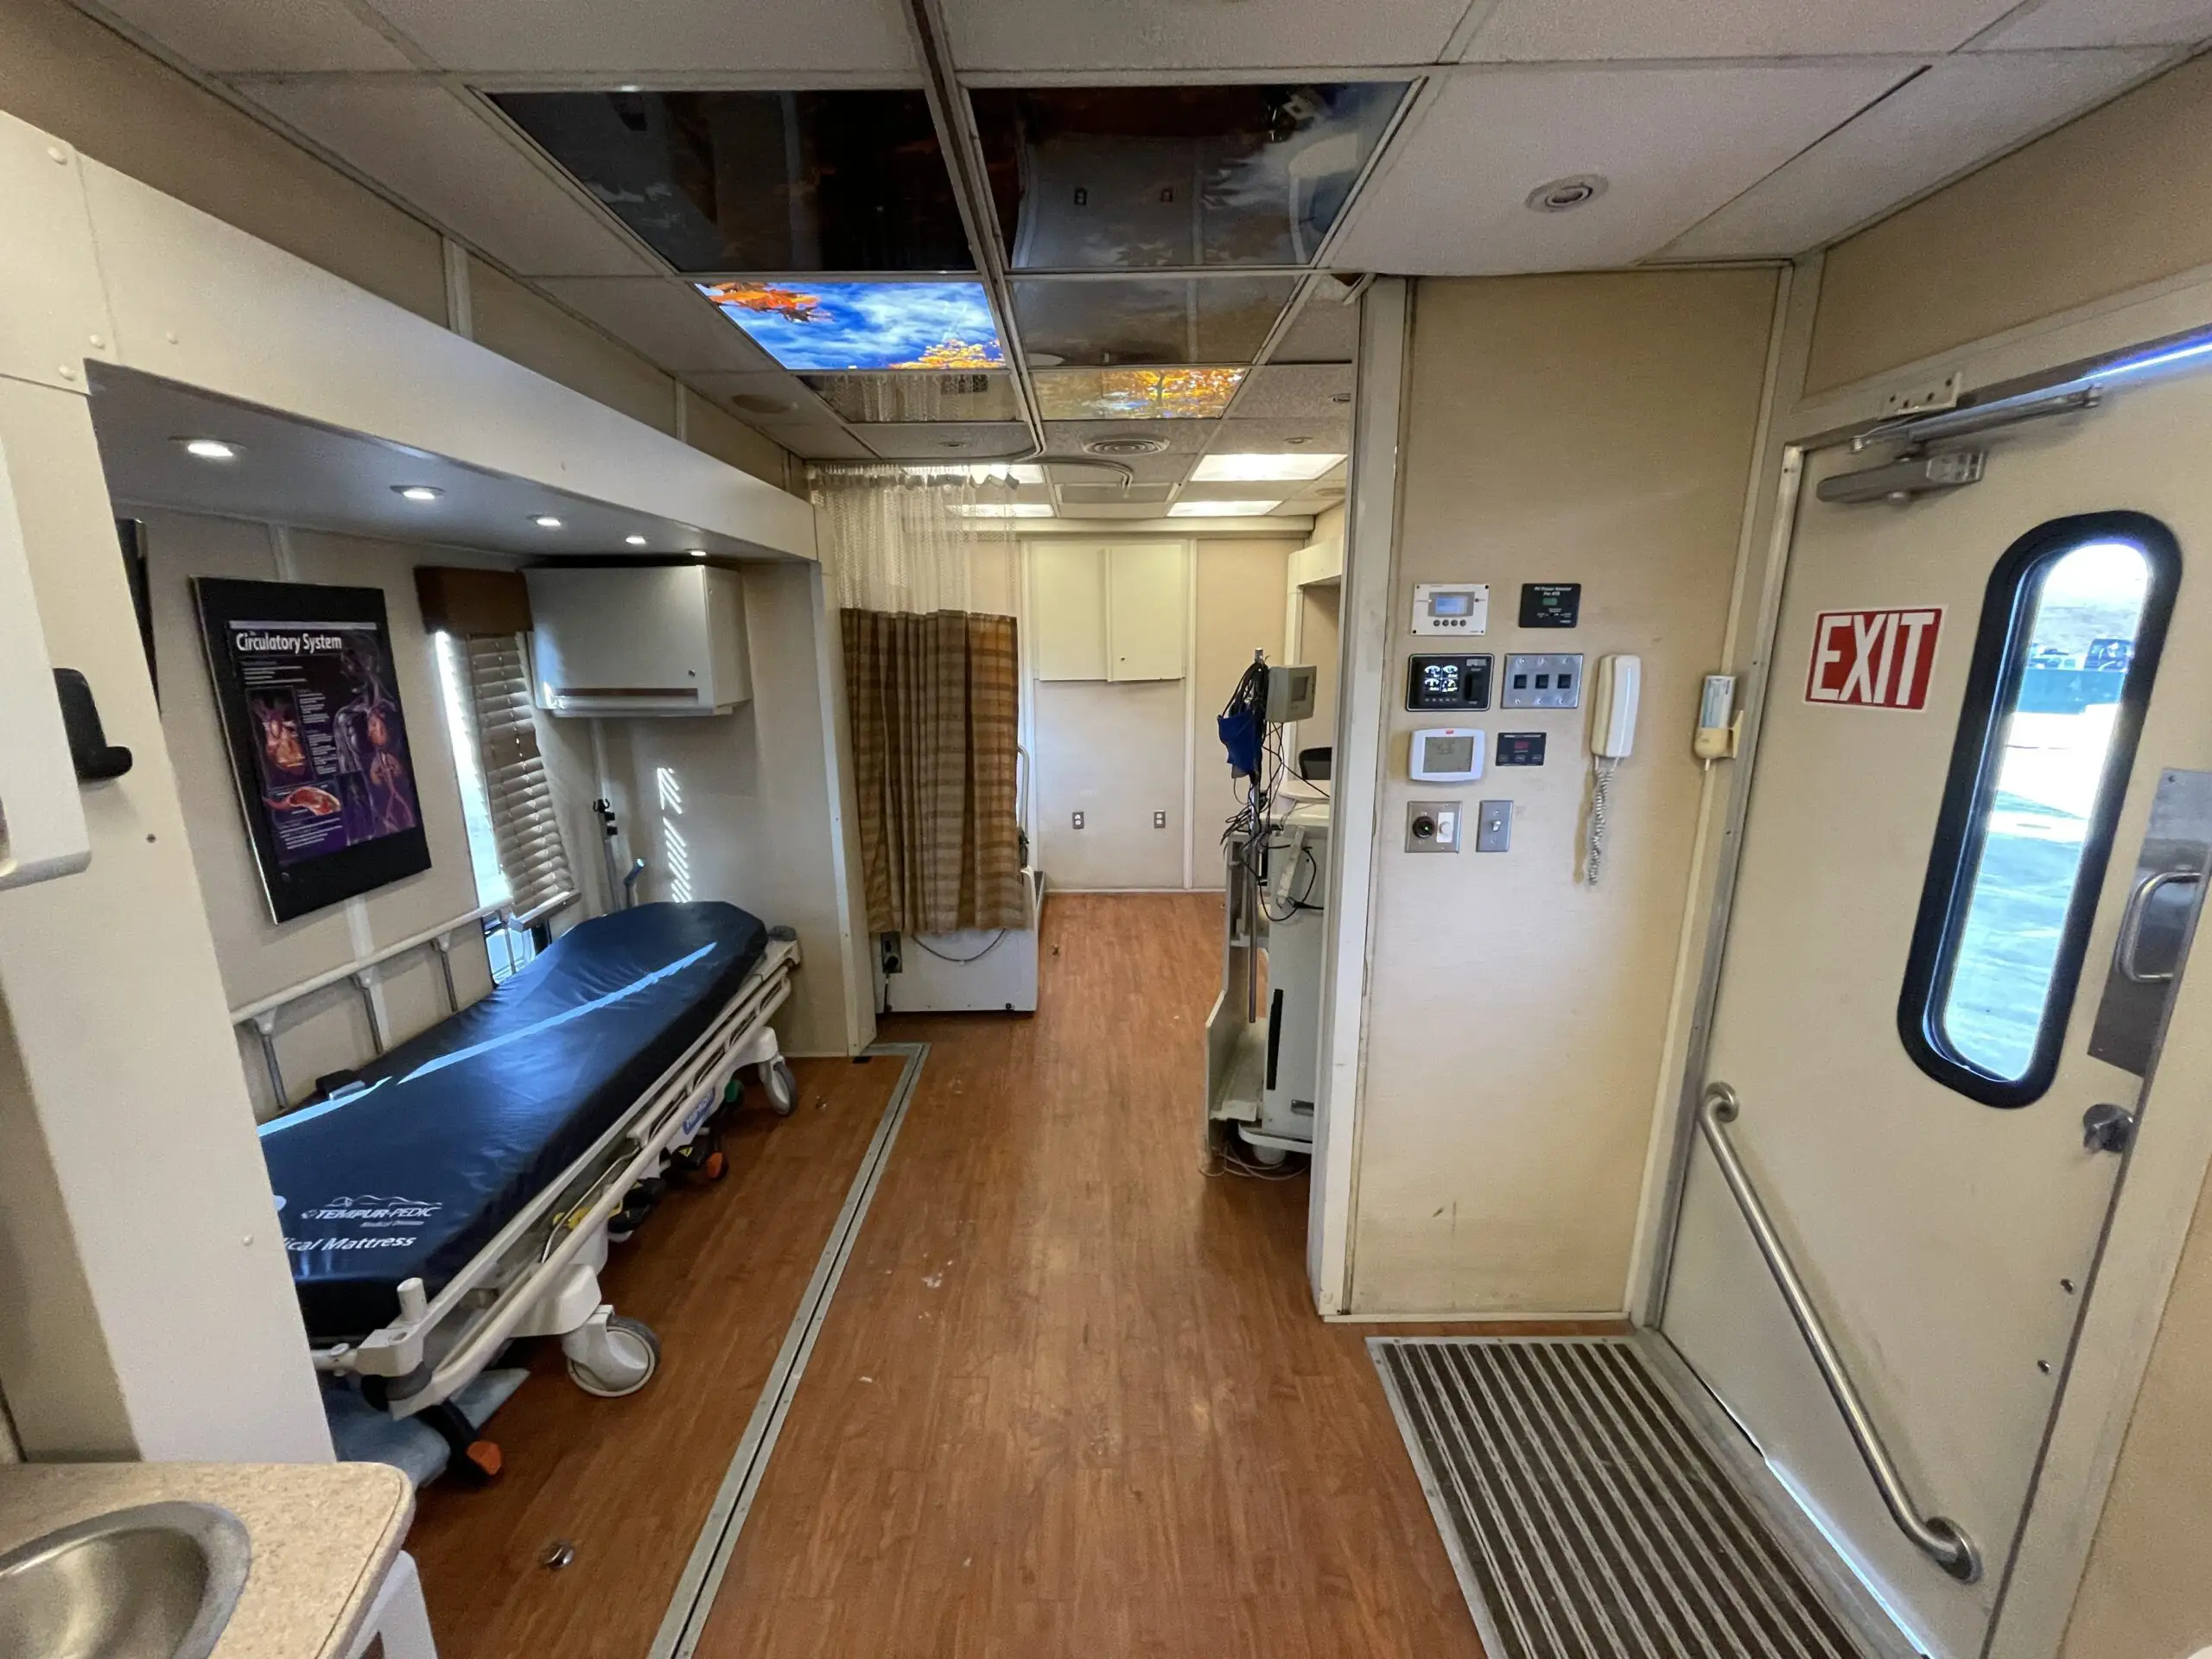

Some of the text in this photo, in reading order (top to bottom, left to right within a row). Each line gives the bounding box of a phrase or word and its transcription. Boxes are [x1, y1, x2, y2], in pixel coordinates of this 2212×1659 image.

[236, 632, 342, 654] Circulatory System
[1810, 612, 1936, 706] EXIT
[315, 1207, 442, 1219] TEMPUR-PEDIC
[283, 1237, 416, 1251] ical Mattress
